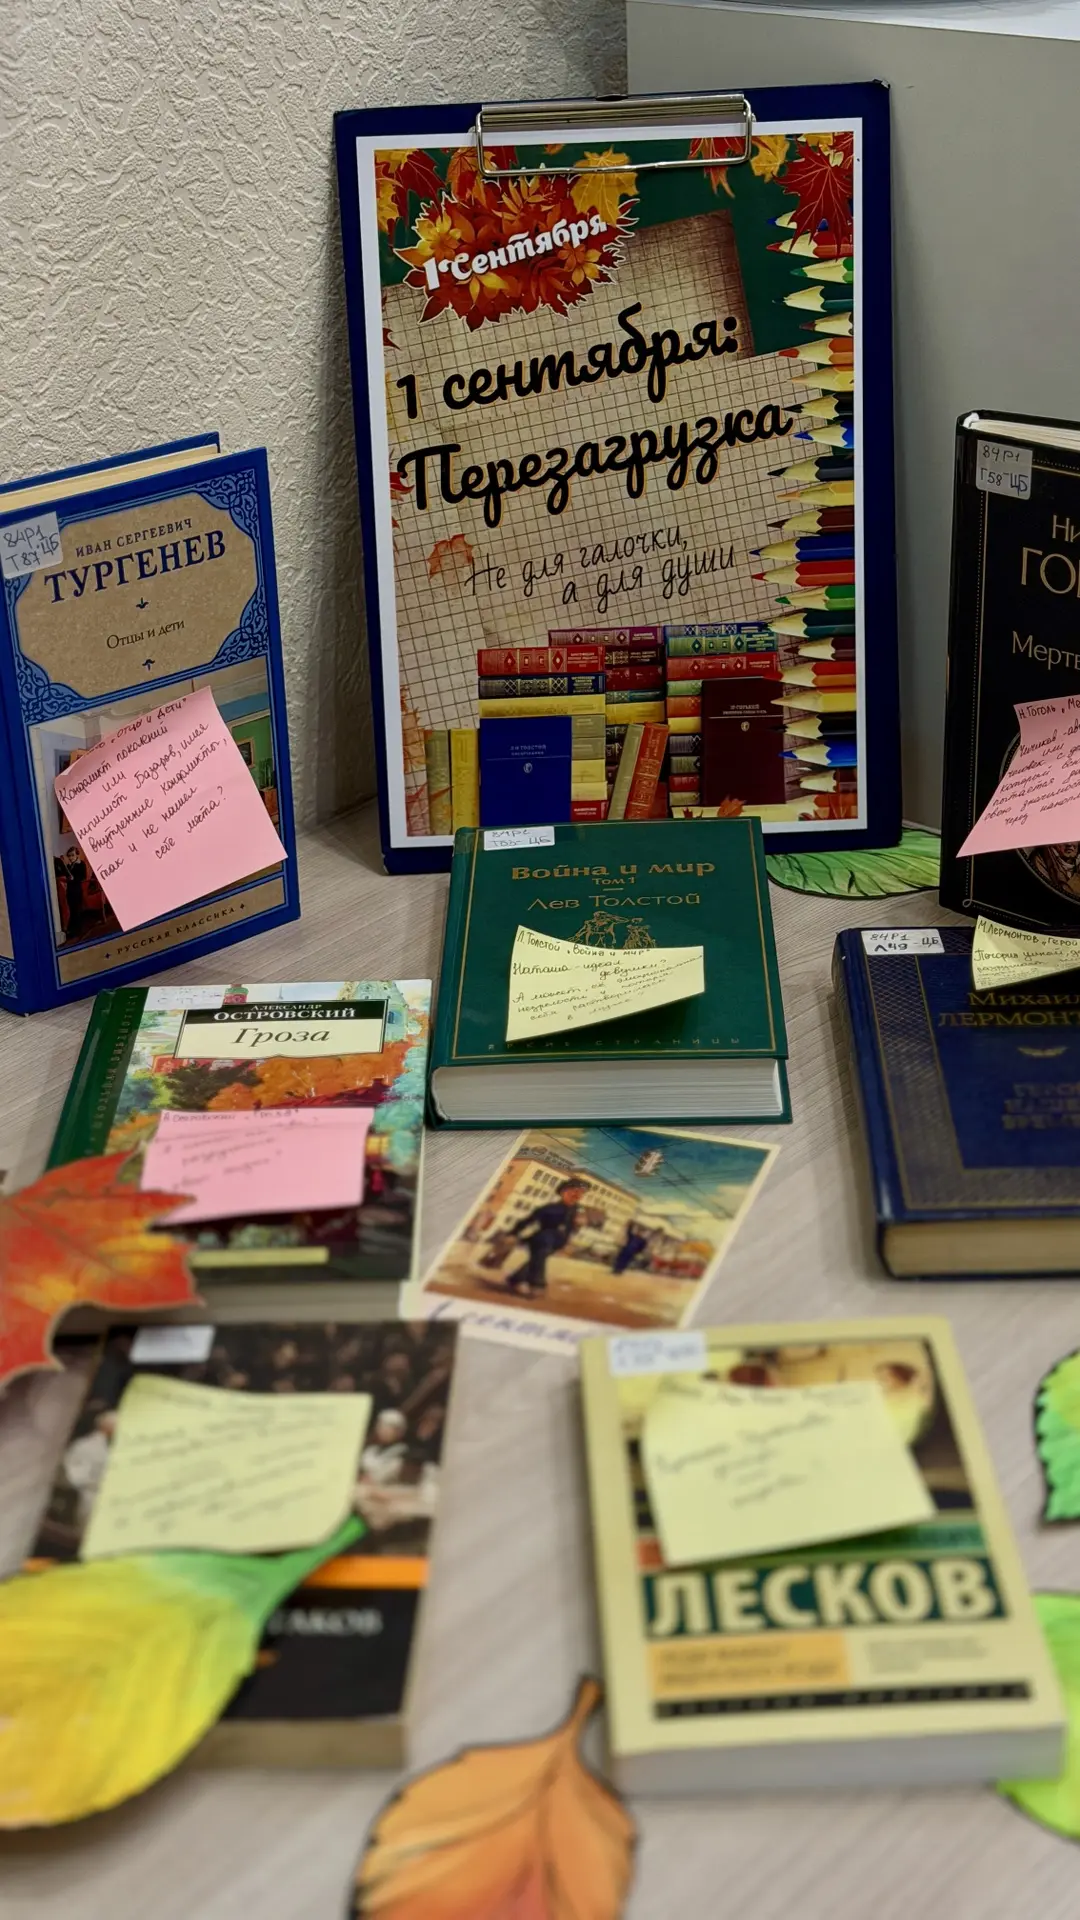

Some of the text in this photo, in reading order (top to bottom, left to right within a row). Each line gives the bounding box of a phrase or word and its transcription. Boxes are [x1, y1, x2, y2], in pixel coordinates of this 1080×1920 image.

[440, 209, 608, 282] Сентября
[396, 302, 740, 420] 1 сентября:
[398, 403, 794, 528] Перезагрузка
[75, 518, 193, 558] ИВАН СЕРГЕЕВИЧ
[44, 530, 226, 603] ТУРГЕНЕВ
[464, 525, 688, 598] Не для галочки,
[562, 545, 735, 614] а для души
[1021, 547, 1080, 598] ГО
[106, 620, 185, 649] Отцы и дети
[59, 760, 112, 805] Конфликт
[102, 771, 127, 793] или
[77, 792, 128, 840] нигилист
[97, 858, 125, 881] так
[128, 842, 138, 853] и
[142, 823, 159, 838] не
[155, 837, 175, 859] себе
[511, 862, 715, 880] Война и мир
[591, 876, 635, 886] Том 1
[527, 898, 580, 911] Лев
[117, 907, 236, 955] РУССКАЯ КЛАССИКА
[513, 962, 571, 976] Наташа
[214, 1006, 356, 1022] ОСТРОВСКИЙ
[250, 1003, 322, 1011] АЛЕКСАНДР
[231, 1027, 330, 1048] Гроза
[650, 1556, 997, 1636] ЛЕСКОВ
